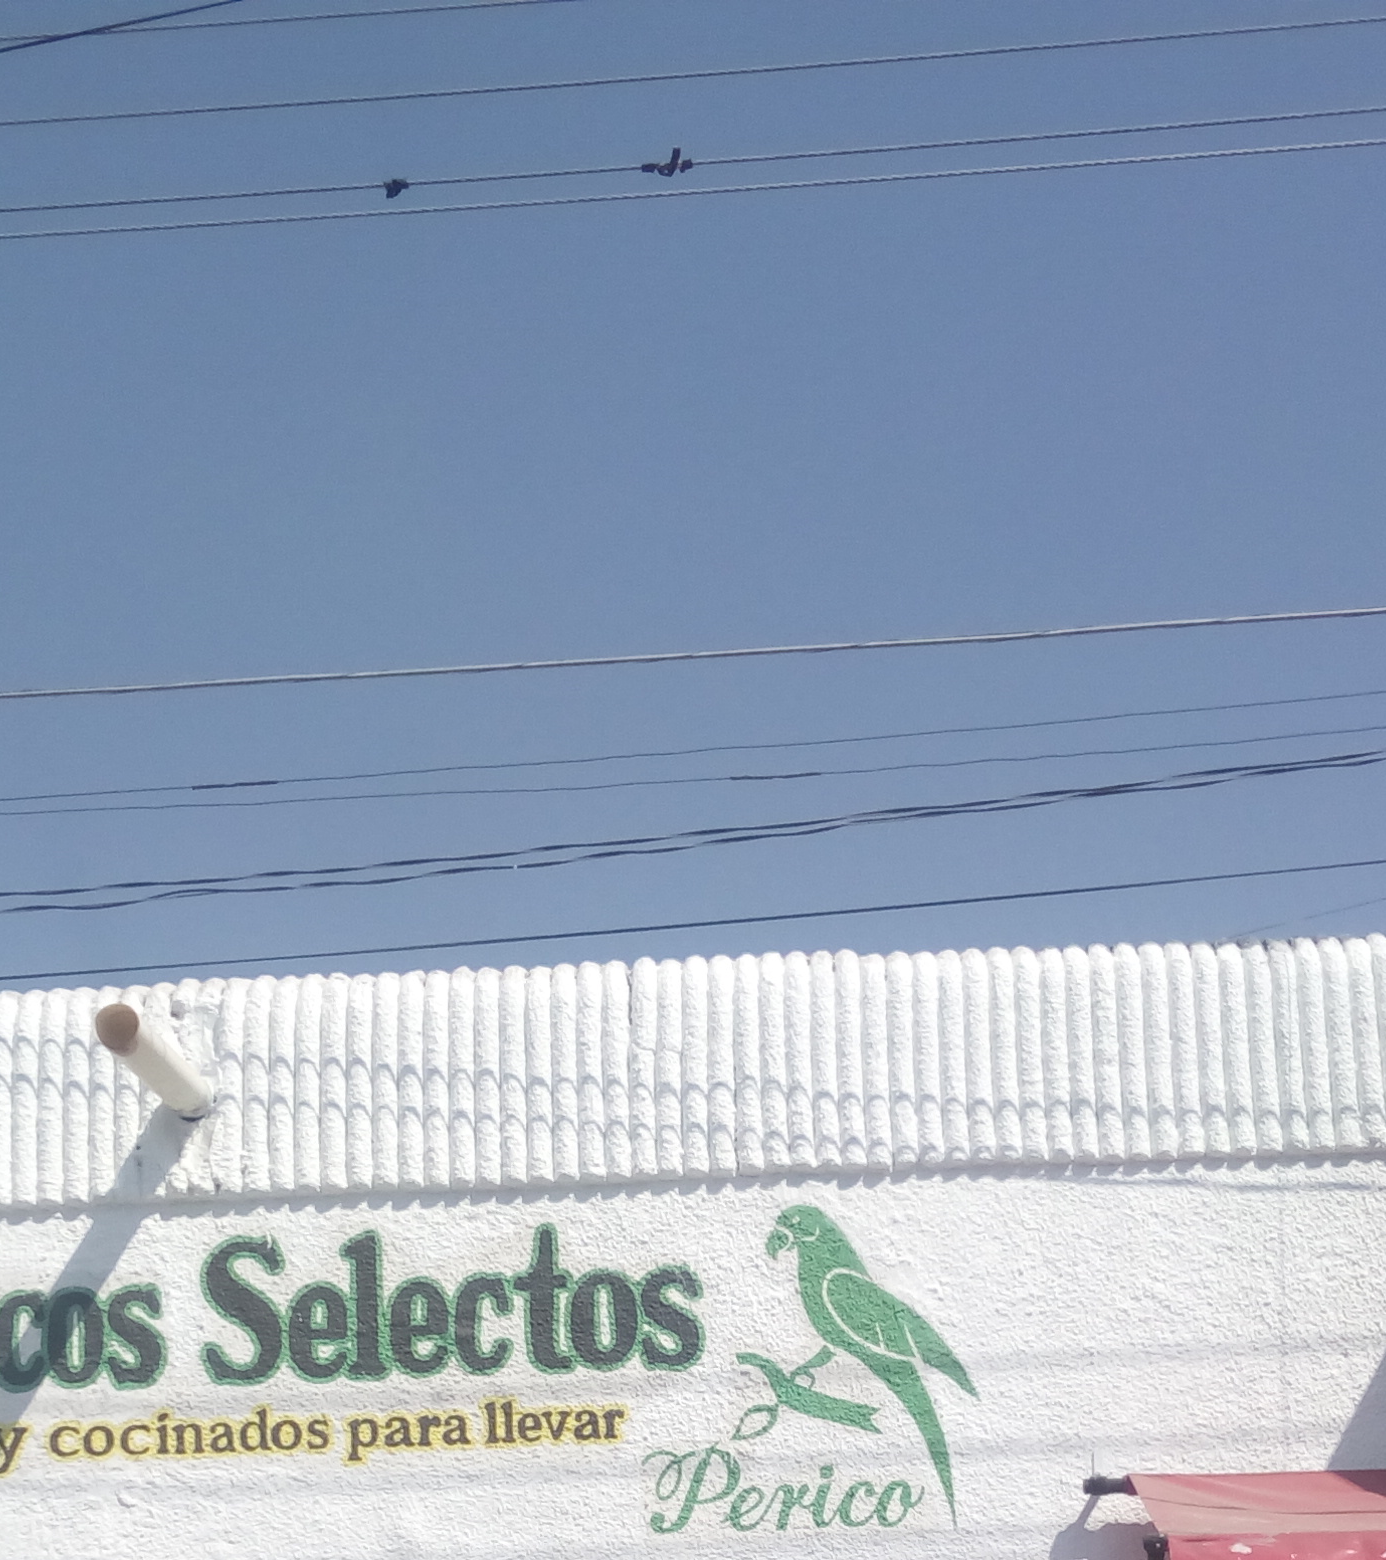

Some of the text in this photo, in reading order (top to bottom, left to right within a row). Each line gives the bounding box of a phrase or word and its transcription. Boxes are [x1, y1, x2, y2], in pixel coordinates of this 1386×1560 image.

[200, 1222, 704, 1386] Selectos
[49, 1408, 330, 1457] cocinados
[347, 1409, 470, 1462] para
[484, 1401, 627, 1445] llevar
[642, 1442, 925, 1533] Perico
